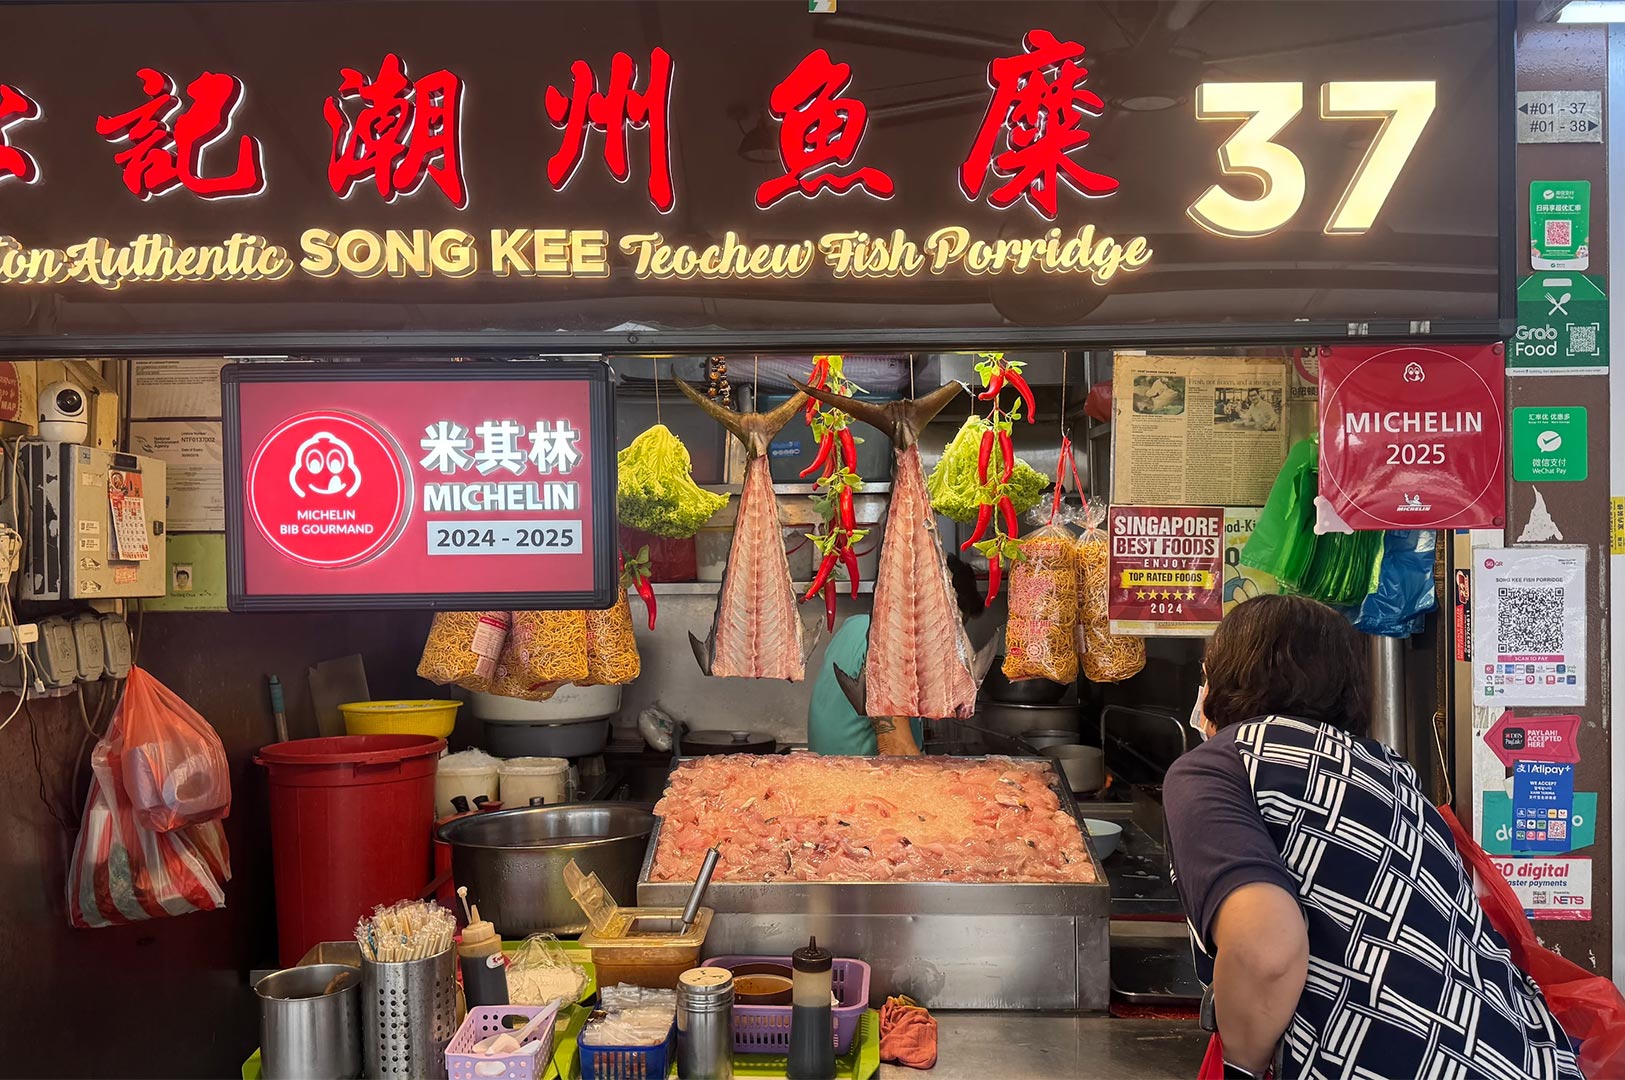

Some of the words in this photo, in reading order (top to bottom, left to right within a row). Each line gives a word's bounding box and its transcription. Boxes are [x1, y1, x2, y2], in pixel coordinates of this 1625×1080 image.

[1530, 103, 1554, 114] #01
[1569, 102, 1586, 114] 37
[1530, 120, 1554, 132] #01
[1569, 120, 1586, 132] 38
[1186, 81, 1437, 238] 37
[0, 236, 70, 283] on
[67, 233, 294, 290] Authentic
[299, 228, 478, 278] SONG
[490, 228, 610, 278] KEE
[619, 231, 815, 279] Teochew
[818, 228, 924, 279] Fish
[926, 224, 1154, 286] Porridge
[1515, 324, 1558, 340] Grab
[1516, 341, 1557, 356] Food
[1345, 411, 1482, 433] MICHELIN
[419, 419, 583, 476] 米其林
[1386, 443, 1446, 465] 2025
[1532, 458, 1566, 467] 微信支付
[423, 481, 580, 512] MICHELIN
[297, 509, 356, 520] MICHELIN
[280, 523, 299, 535] BIB
[301, 523, 374, 535] GOURMAND
[1114, 516, 1219, 536] SINGAPORE
[437, 529, 495, 547] 2024
[516, 529, 574, 547] 2025
[1116, 537, 1157, 555] BEST
[1162, 537, 1215, 556] FOODS
[1144, 559, 1187, 568] ENJOY
[1129, 572, 1144, 581] TOP
[1146, 572, 1173, 582] RATED
[1175, 573, 1202, 582] FOODS
[1151, 603, 1183, 614] 2024
[1517, 863, 1570, 880] digital
[1553, 896, 1584, 905] NETS
